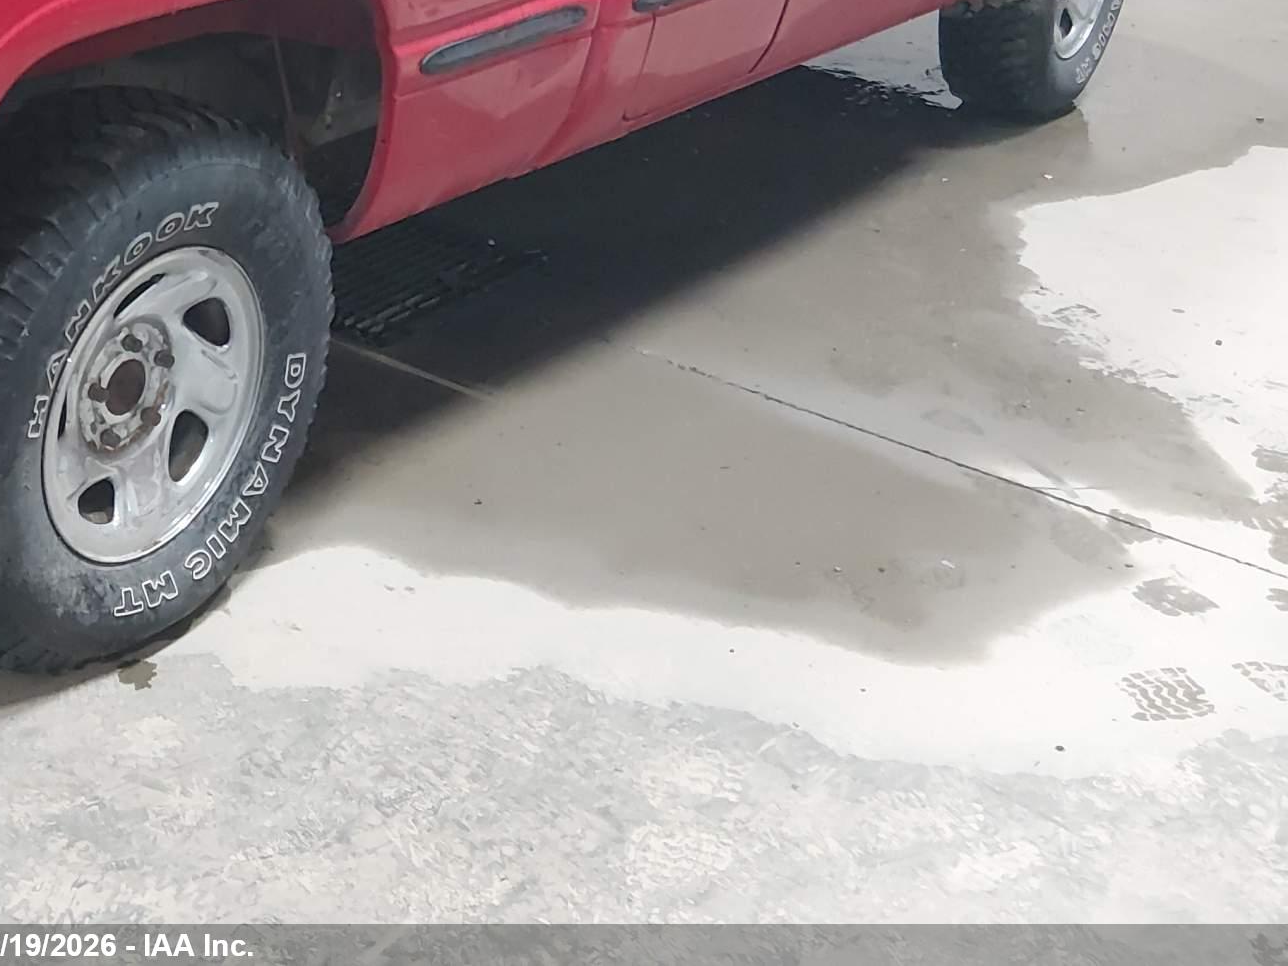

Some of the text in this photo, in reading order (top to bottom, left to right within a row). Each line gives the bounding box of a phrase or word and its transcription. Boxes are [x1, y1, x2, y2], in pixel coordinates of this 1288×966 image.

[27, 201, 219, 438] HANKOOK
[114, 353, 307, 617] DYNAMIC MT
